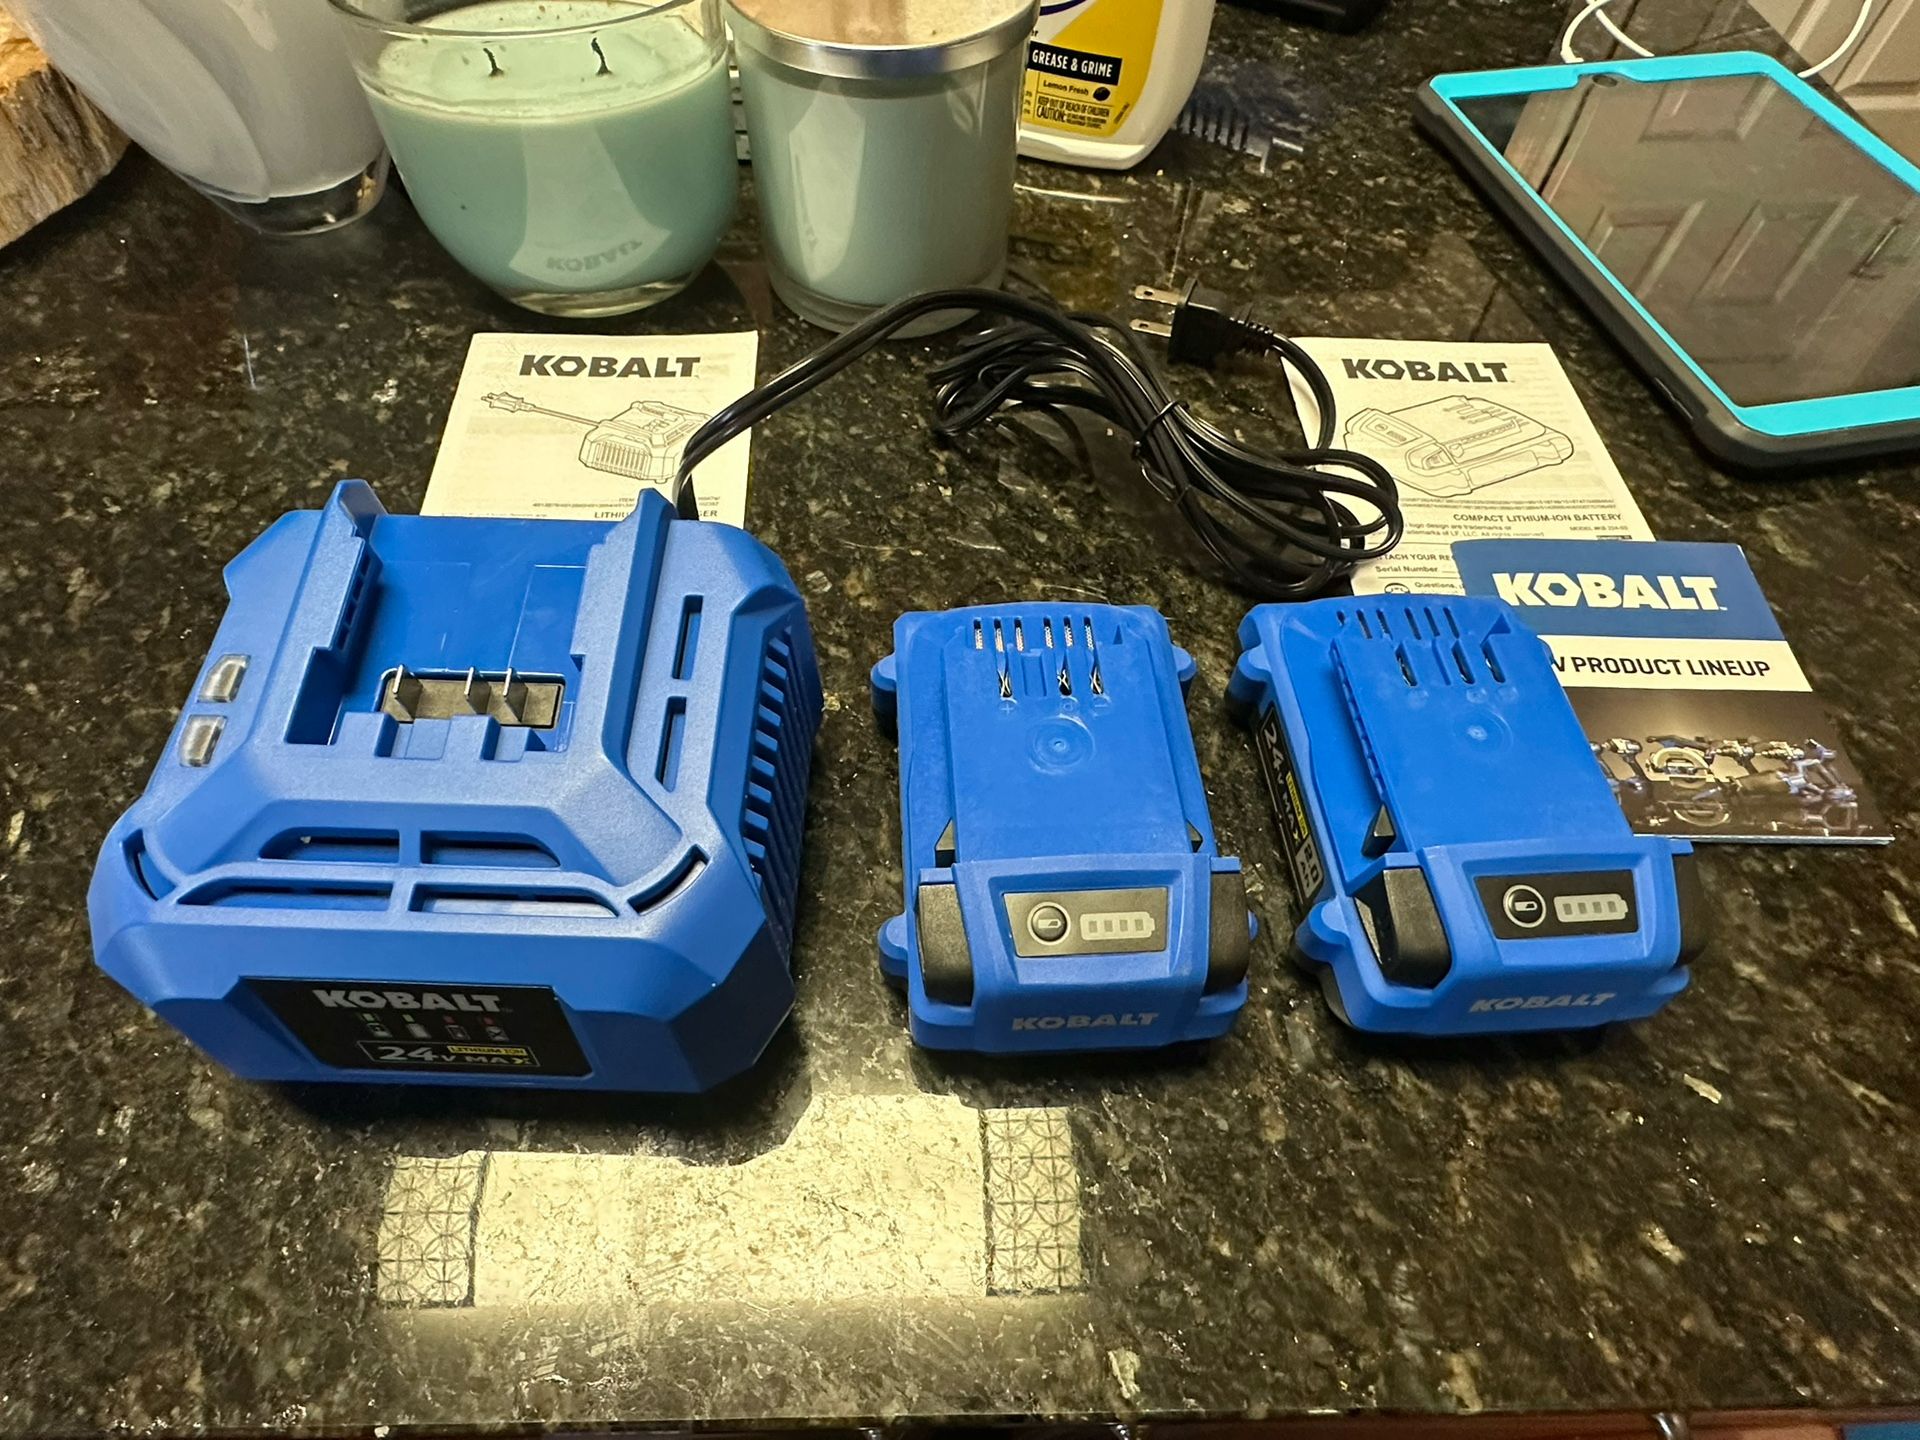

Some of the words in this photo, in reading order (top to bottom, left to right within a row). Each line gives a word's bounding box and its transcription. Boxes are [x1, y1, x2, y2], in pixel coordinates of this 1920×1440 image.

[1032, 50, 1069, 69] GREASE
[1070, 58, 1078, 71] &
[1081, 60, 1113, 77] GRIME
[1043, 80, 1068, 91] Lemon
[1068, 85, 1089, 95] Fresh
[519, 354, 701, 378] KOBALT
[1341, 358, 1508, 383] KOBALT
[1453, 513, 1504, 522] COMPACT
[1506, 514, 1572, 522] LITHIUM-ION
[1573, 513, 1622, 521] BATTERY
[1492, 573, 1720, 611] KOBALT
[1574, 656, 1682, 676] PRODUCT
[1688, 659, 1771, 678] LINEUP
[312, 989, 501, 1013] KOBALT
[1469, 992, 1617, 1014] KOBALT
[1011, 1012, 1160, 1031] KOBALT
[465, 1055, 532, 1064] MAX
